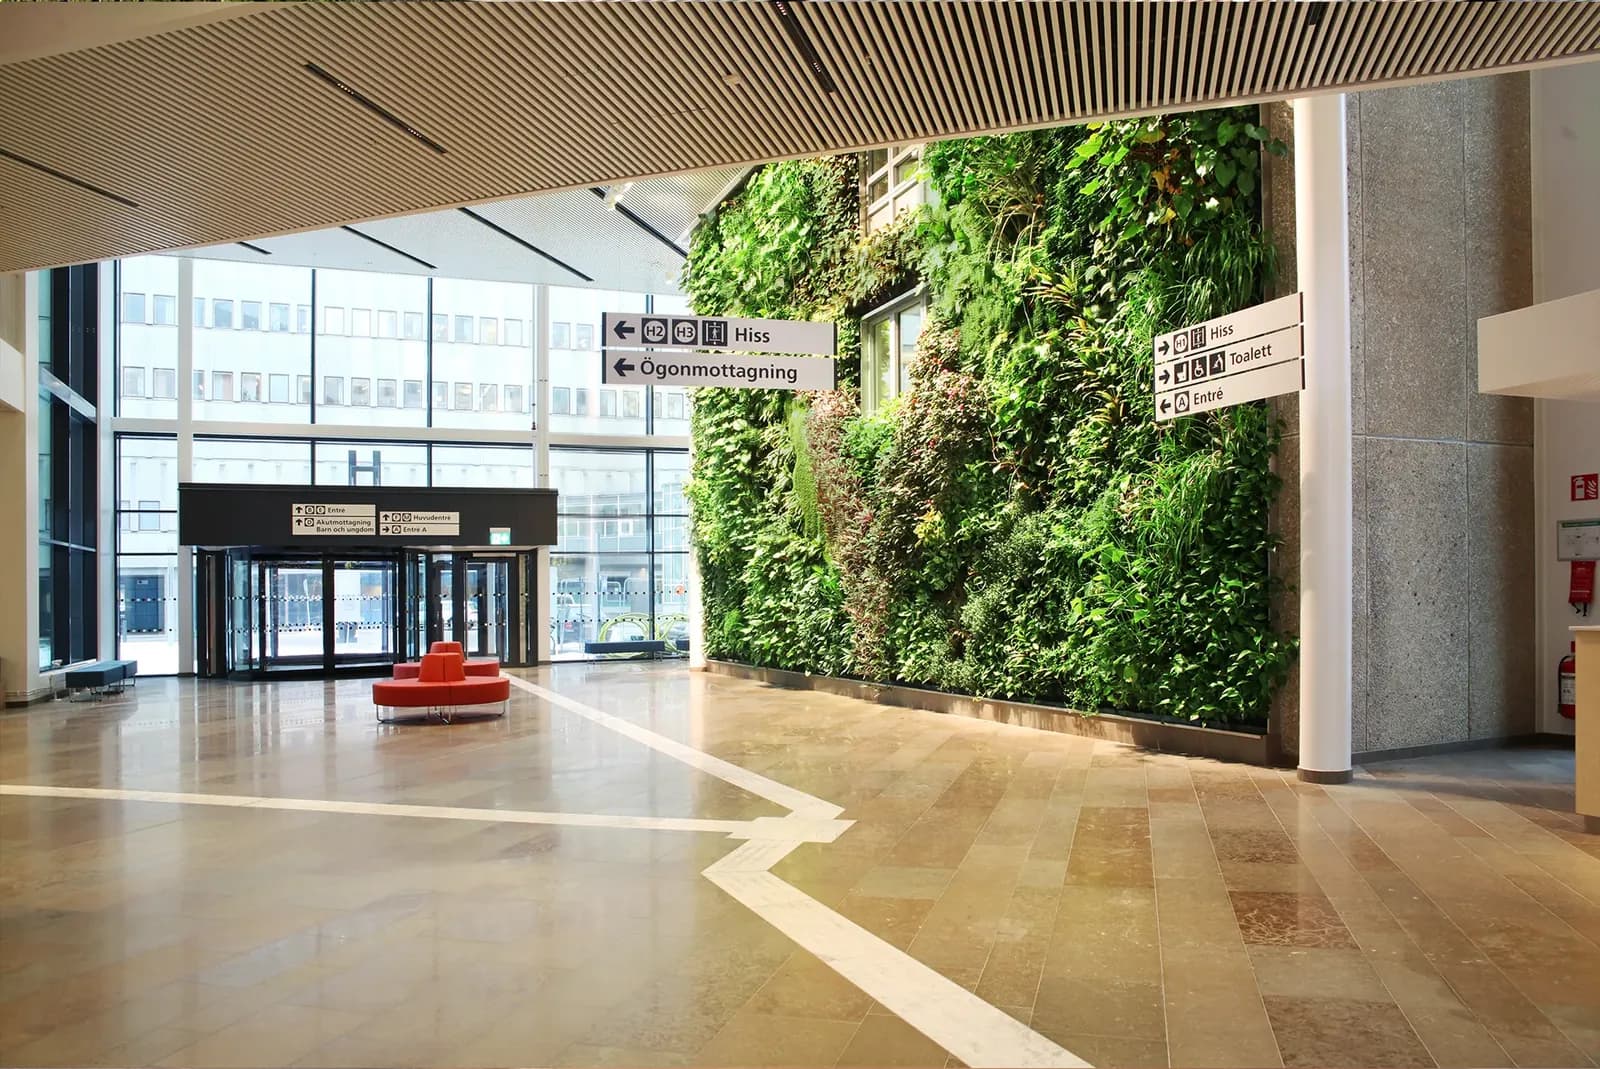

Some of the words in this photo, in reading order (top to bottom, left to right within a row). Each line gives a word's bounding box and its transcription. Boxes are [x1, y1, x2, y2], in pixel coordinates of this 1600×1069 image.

[646, 326, 664, 337] H2
[676, 327, 694, 338] H3
[735, 327, 771, 343] Hiss
[1210, 324, 1234, 340] Hiss
[1229, 344, 1272, 365] Toalett
[640, 357, 798, 383] Ögonmottagning
[1193, 387, 1224, 405] Entré
[348, 450, 381, 486] H
